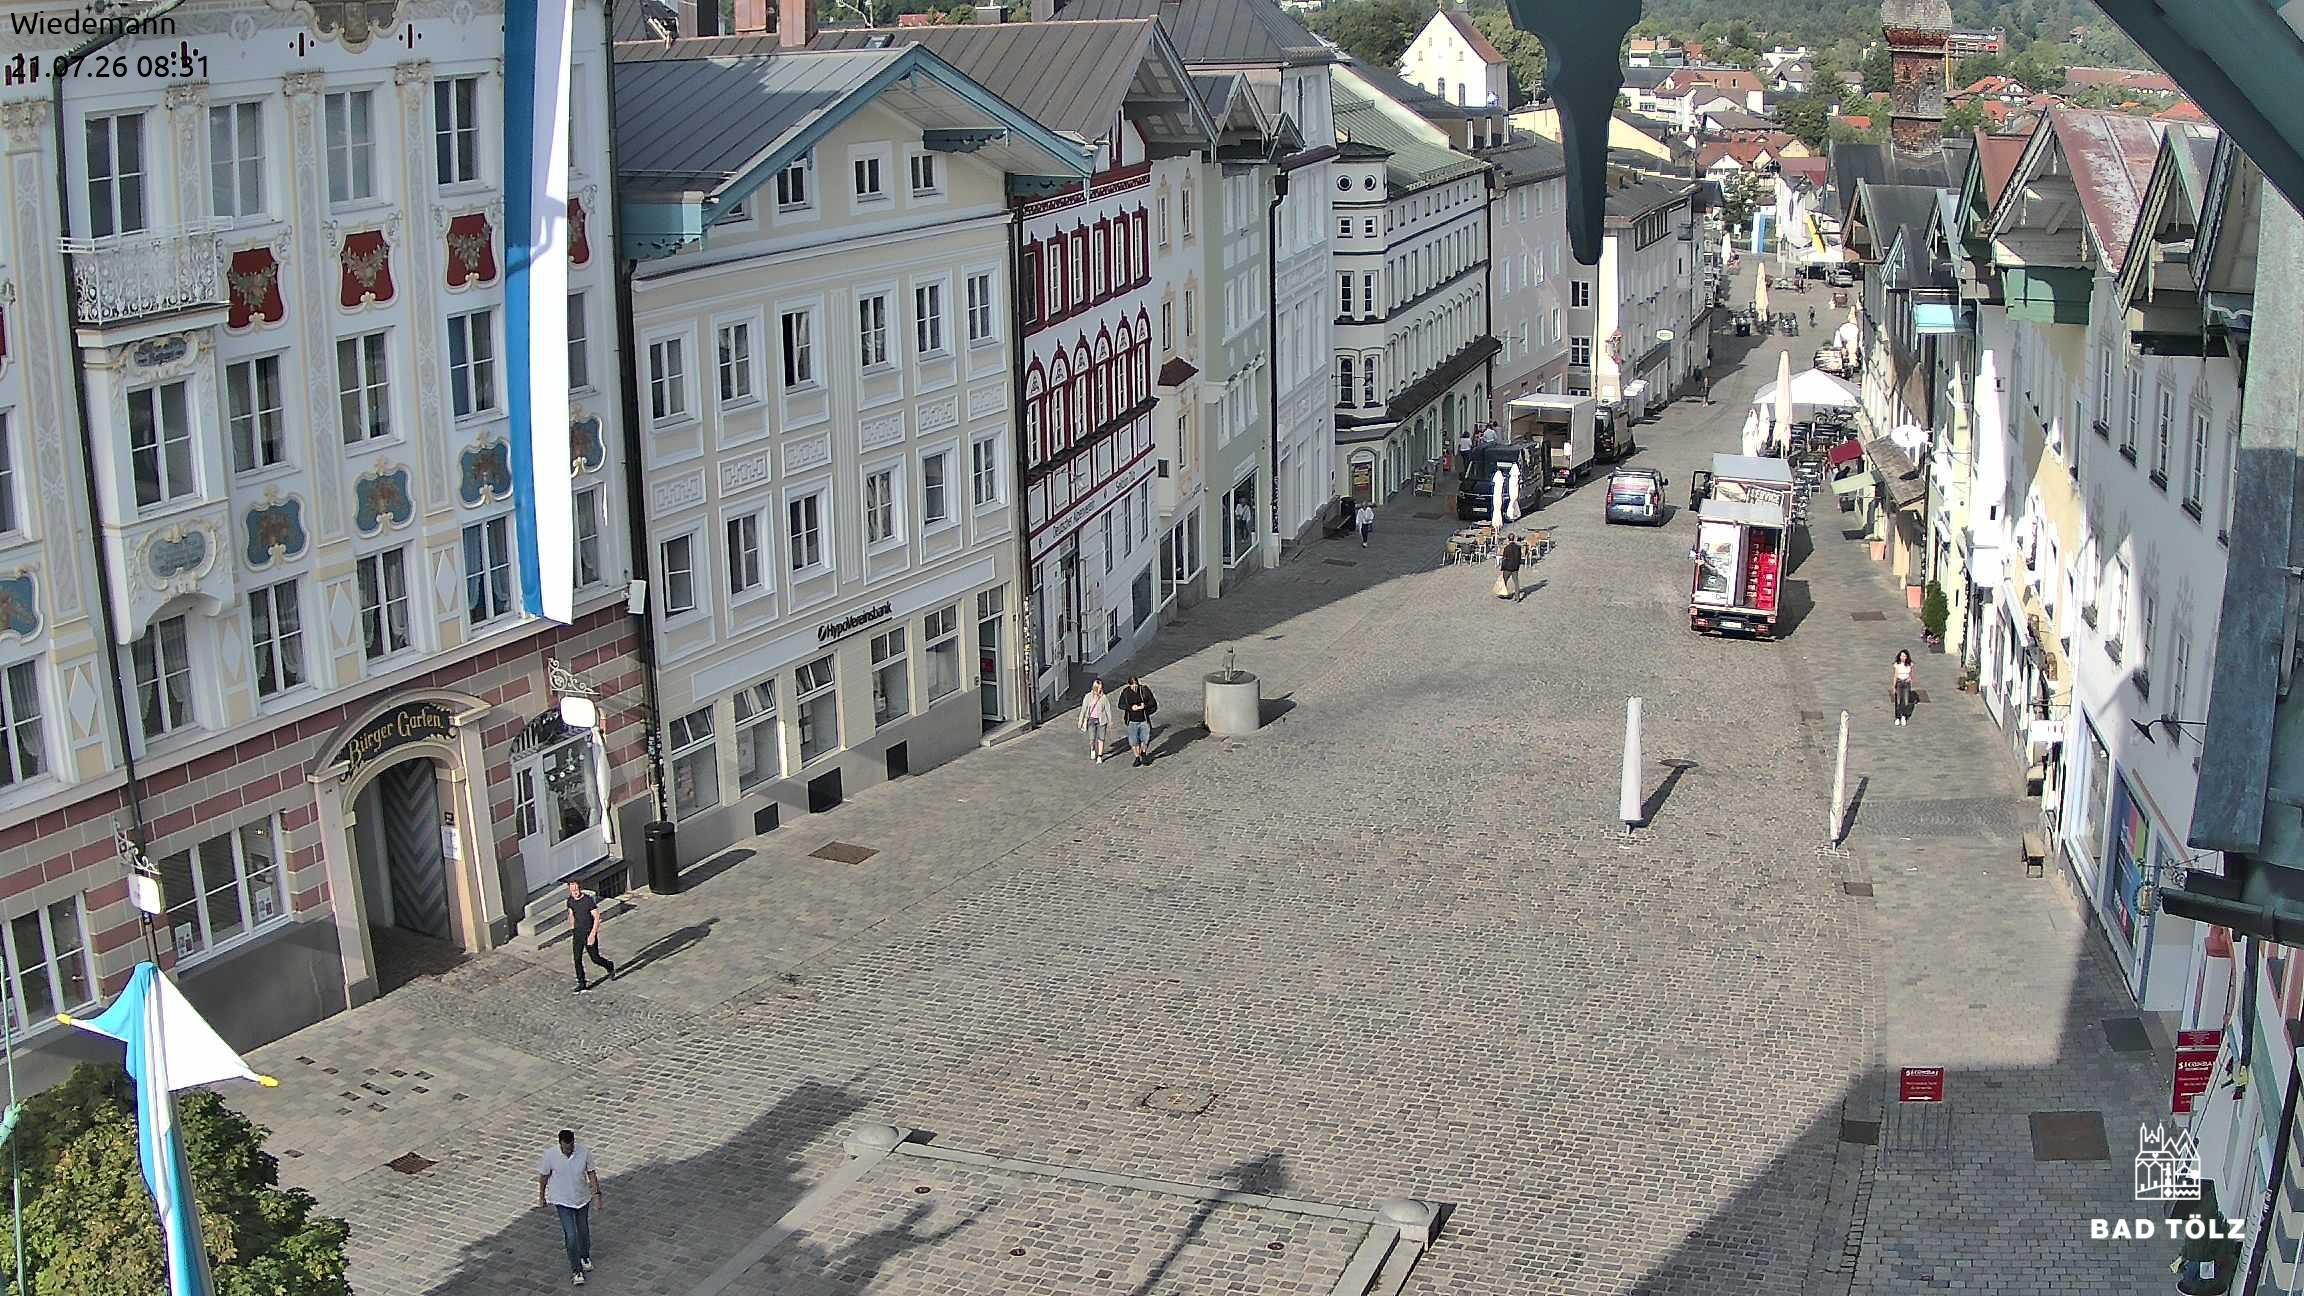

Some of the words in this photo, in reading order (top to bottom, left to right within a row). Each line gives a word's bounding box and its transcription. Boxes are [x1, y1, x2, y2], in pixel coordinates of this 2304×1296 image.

[826, 601, 892, 639] HypoVereinsbank
[349, 722, 393, 767] Bürger
[397, 708, 442, 737] Garten
